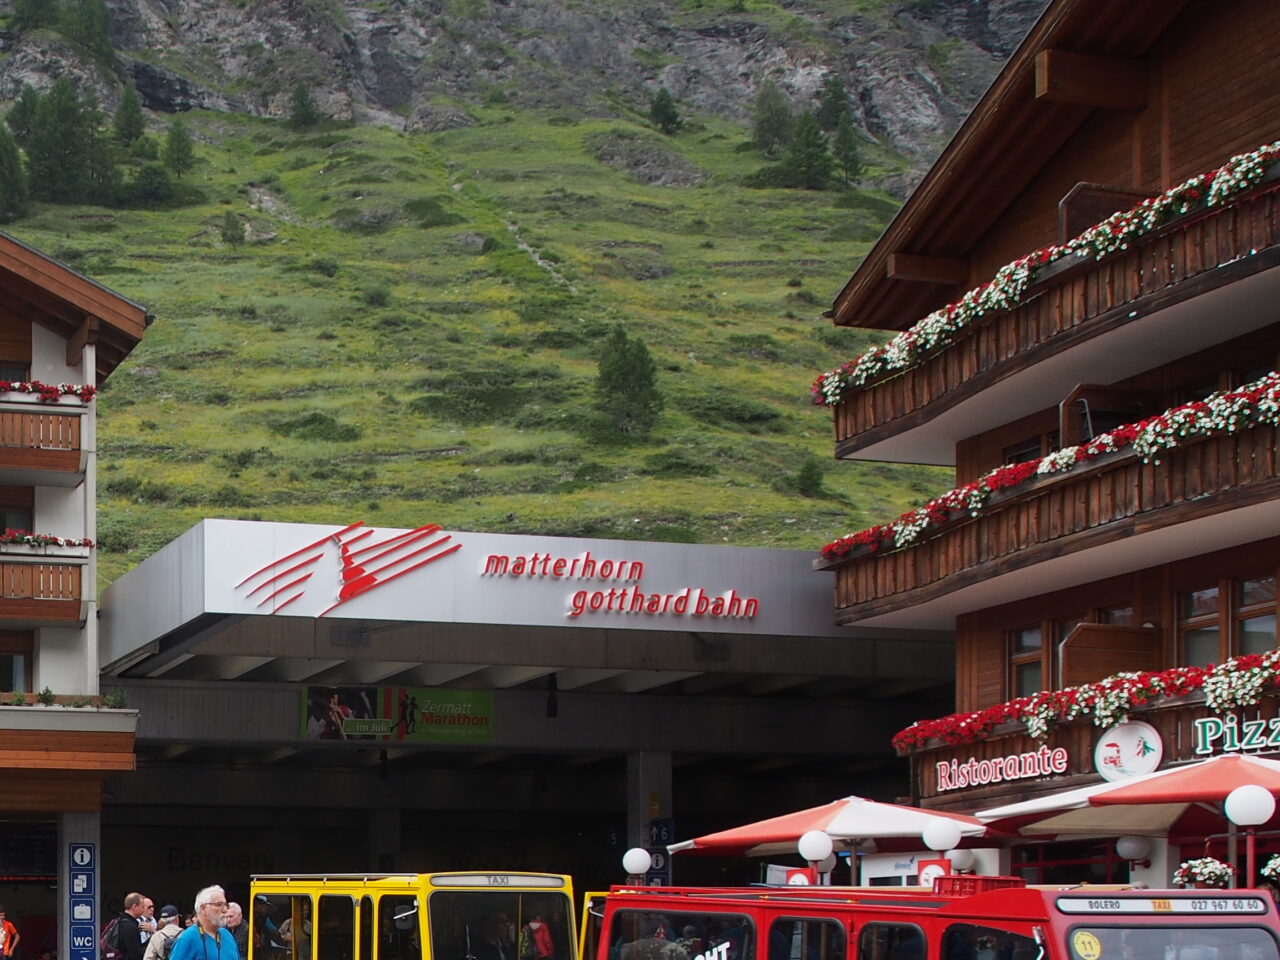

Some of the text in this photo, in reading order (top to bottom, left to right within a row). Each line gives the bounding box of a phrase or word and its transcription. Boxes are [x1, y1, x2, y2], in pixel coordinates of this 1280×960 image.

[483, 552, 644, 580] matterhorn
[421, 700, 472, 713] Zermatt
[421, 712, 488, 725] Marathon
[371, 721, 388, 732] Juli
[936, 745, 1068, 792] Ristorante
[661, 828, 668, 840] 6
[486, 876, 509, 885] TAXI
[1089, 900, 1258, 910] BOLERO TAXI 027 967 60 60
[74, 937, 92, 946] WC
[1081, 940, 1094, 951] 11
